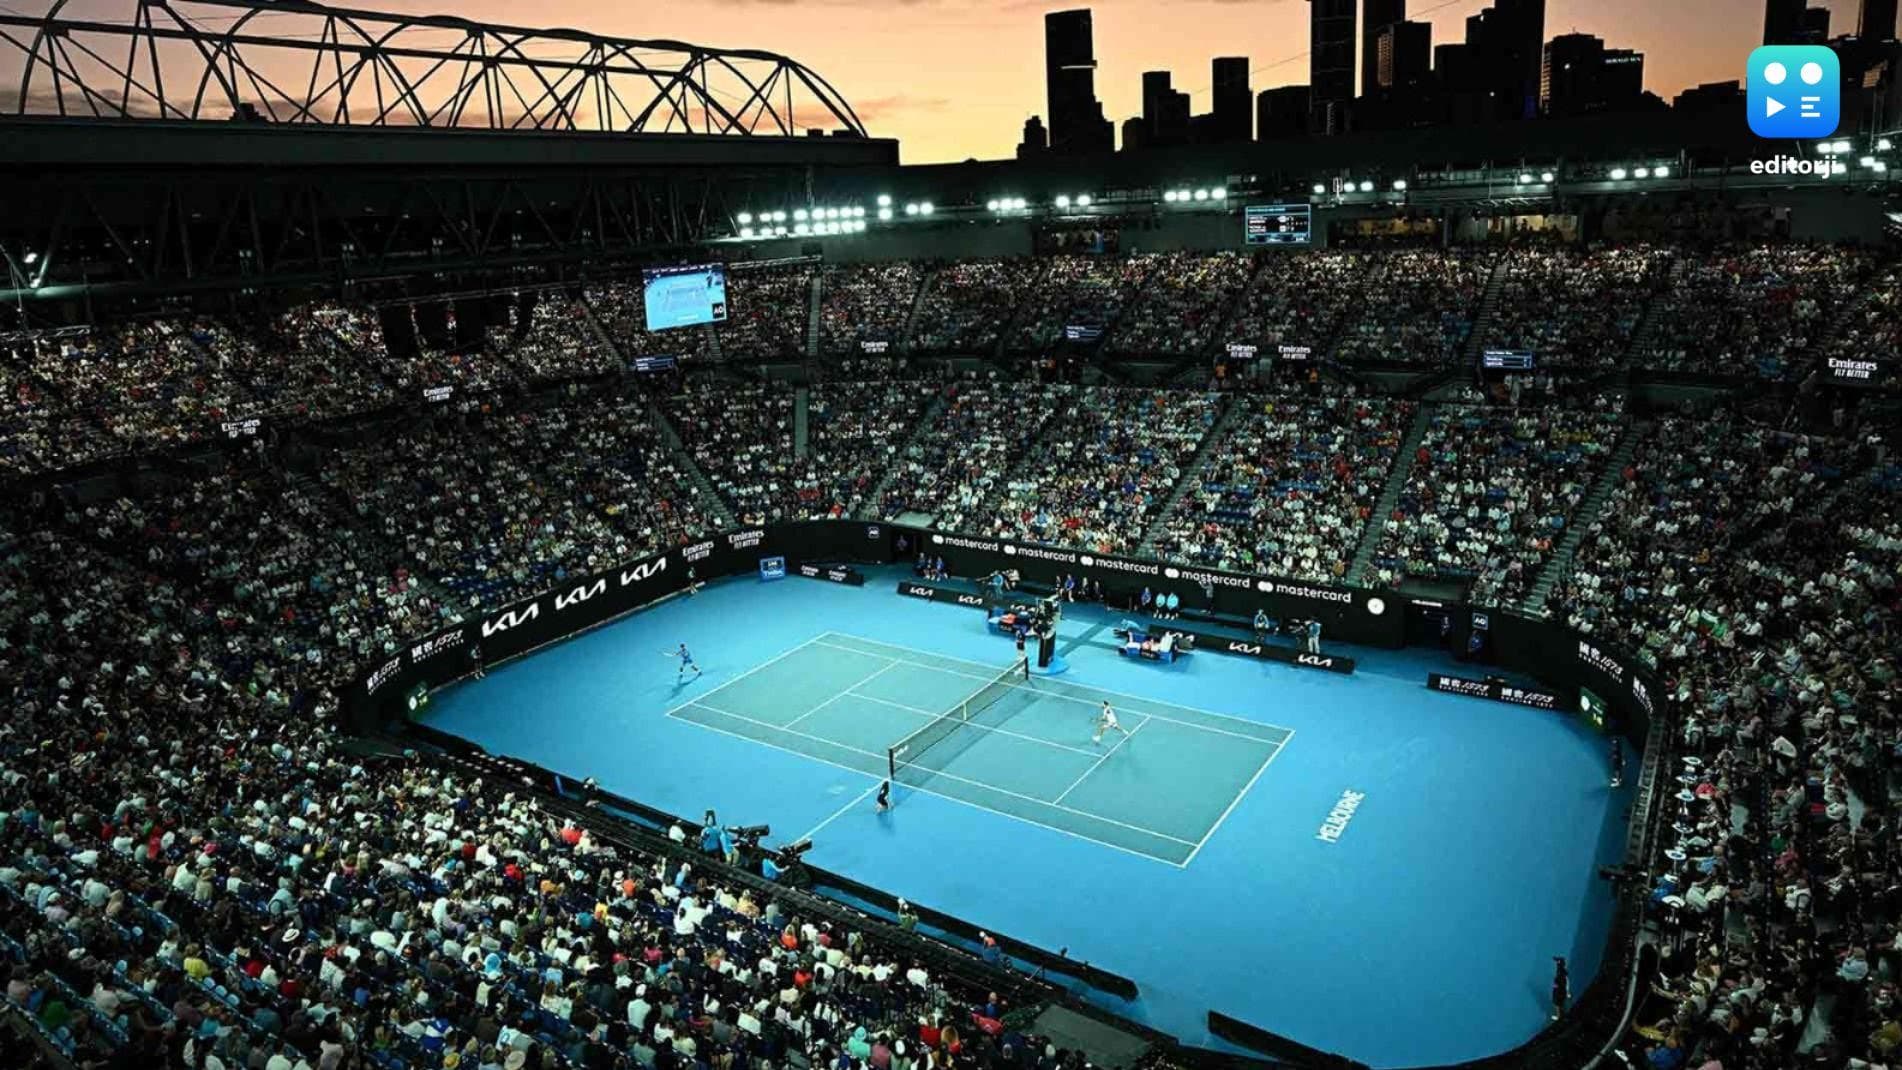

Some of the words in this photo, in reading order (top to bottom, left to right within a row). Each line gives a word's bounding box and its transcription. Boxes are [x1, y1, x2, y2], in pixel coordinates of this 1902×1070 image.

[1828, 358, 1878, 371] Emirates
[945, 536, 999, 551] mastercard
[1018, 547, 1076, 563] mastercard
[620, 556, 667, 586] KIA
[1095, 558, 1159, 575] mastercard
[1181, 570, 1250, 588] mastercard
[555, 578, 607, 611] KIA
[1276, 583, 1351, 603] mastercard
[481, 602, 540, 638] KIA
[1314, 789, 1366, 844] MELBOURNE
